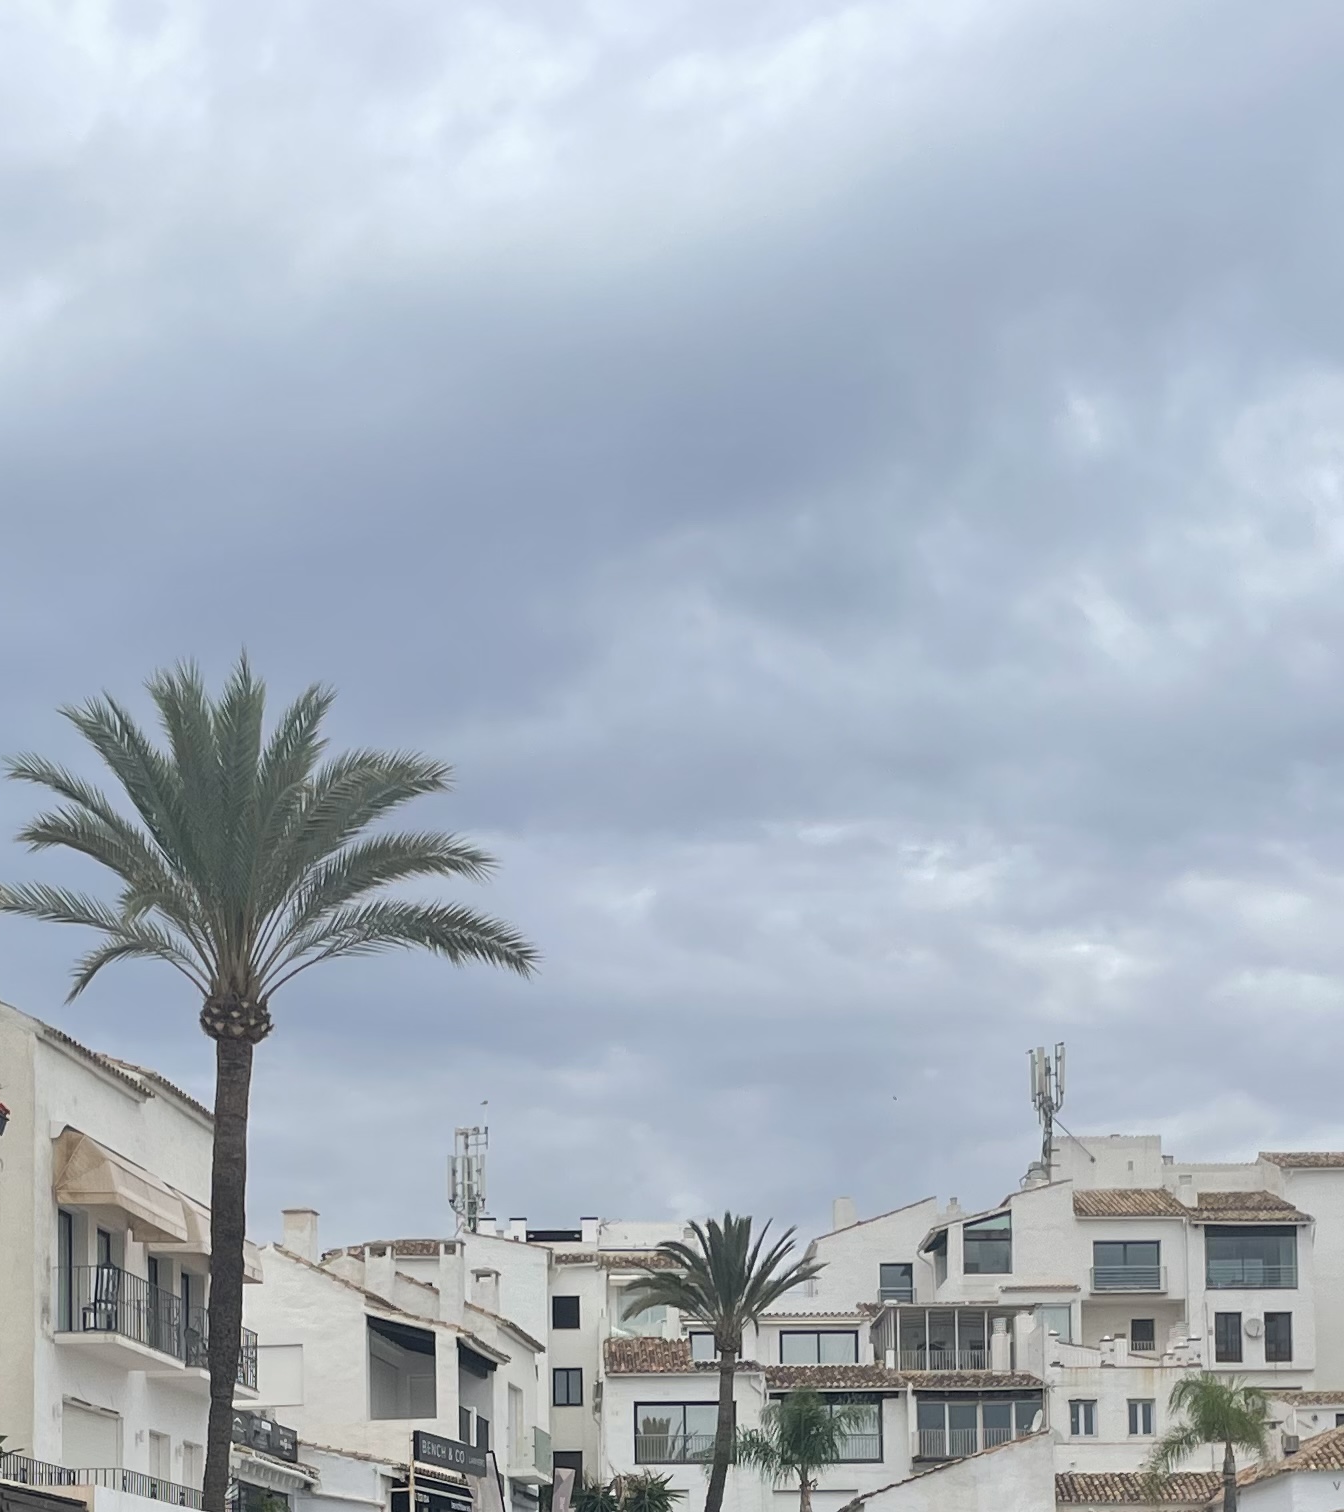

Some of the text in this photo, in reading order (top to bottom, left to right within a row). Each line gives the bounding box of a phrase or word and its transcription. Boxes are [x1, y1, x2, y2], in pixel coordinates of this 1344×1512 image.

[421, 1439, 447, 1459] BENCH
[448, 1447, 454, 1461] &
[455, 1449, 465, 1464] CO
